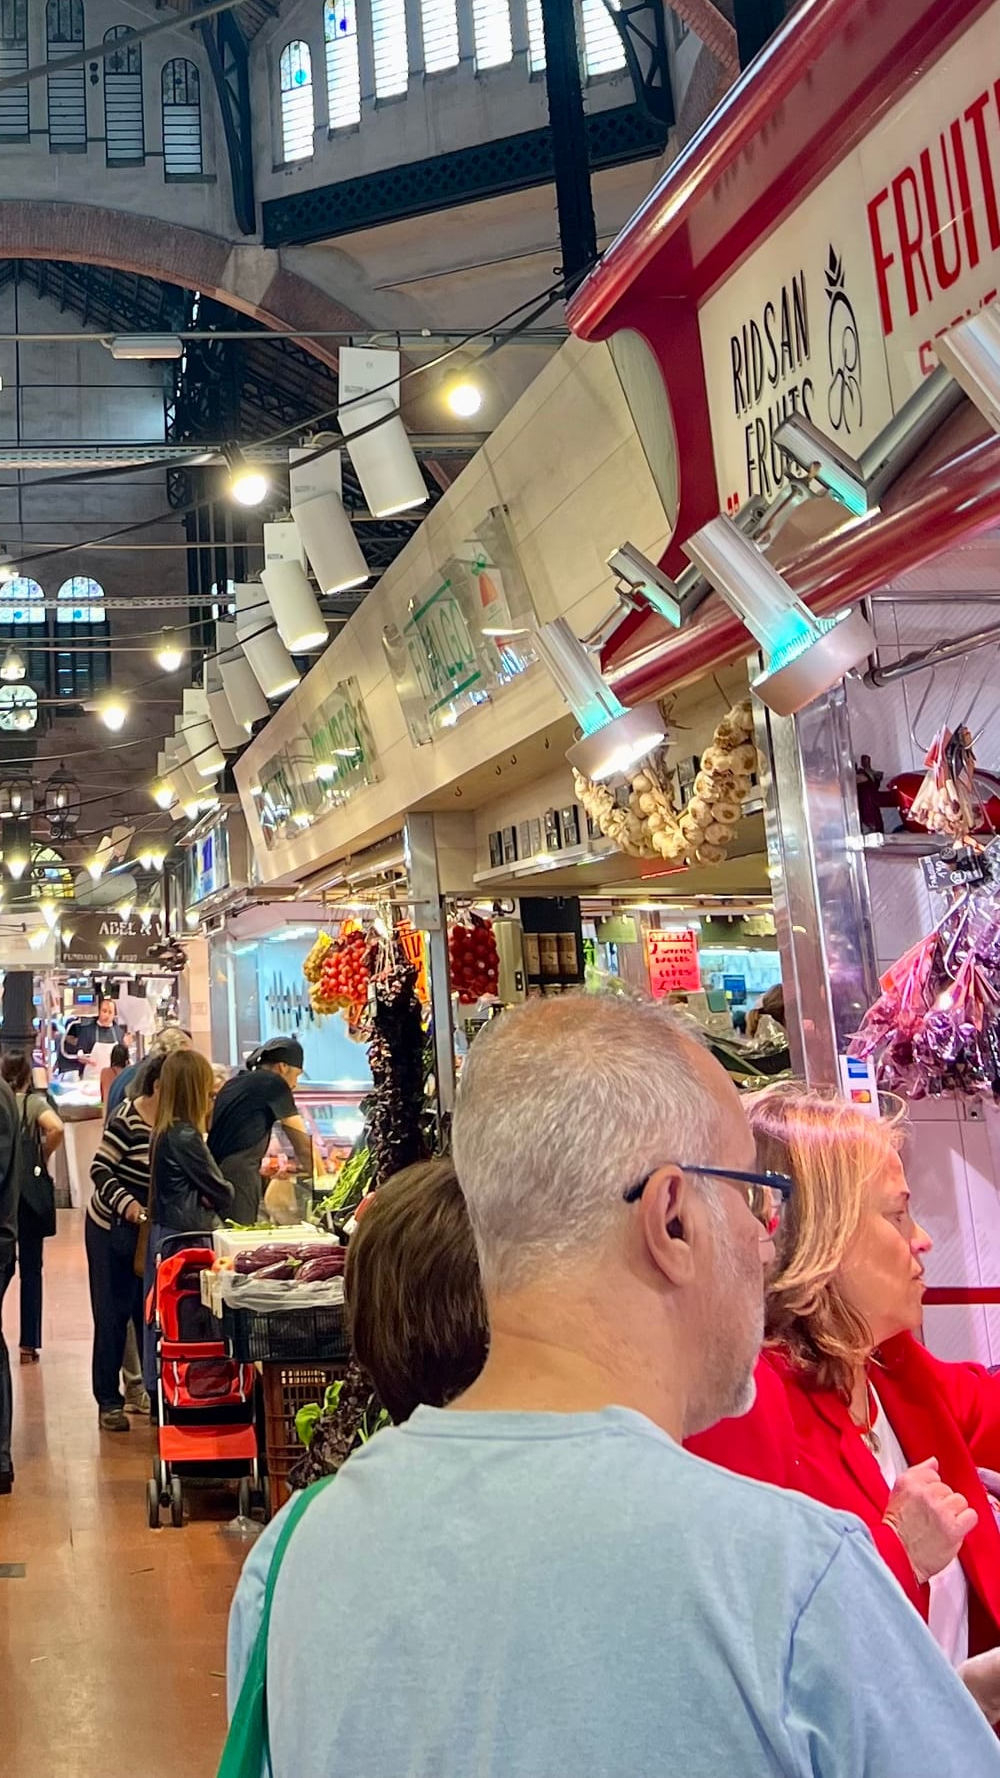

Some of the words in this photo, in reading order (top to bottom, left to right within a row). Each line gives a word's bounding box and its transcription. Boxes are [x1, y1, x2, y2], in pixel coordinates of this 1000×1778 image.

[867, 78, 1000, 336] FRUIT
[729, 270, 811, 417] RIDSAN
[98, 921, 137, 936] ABEL
